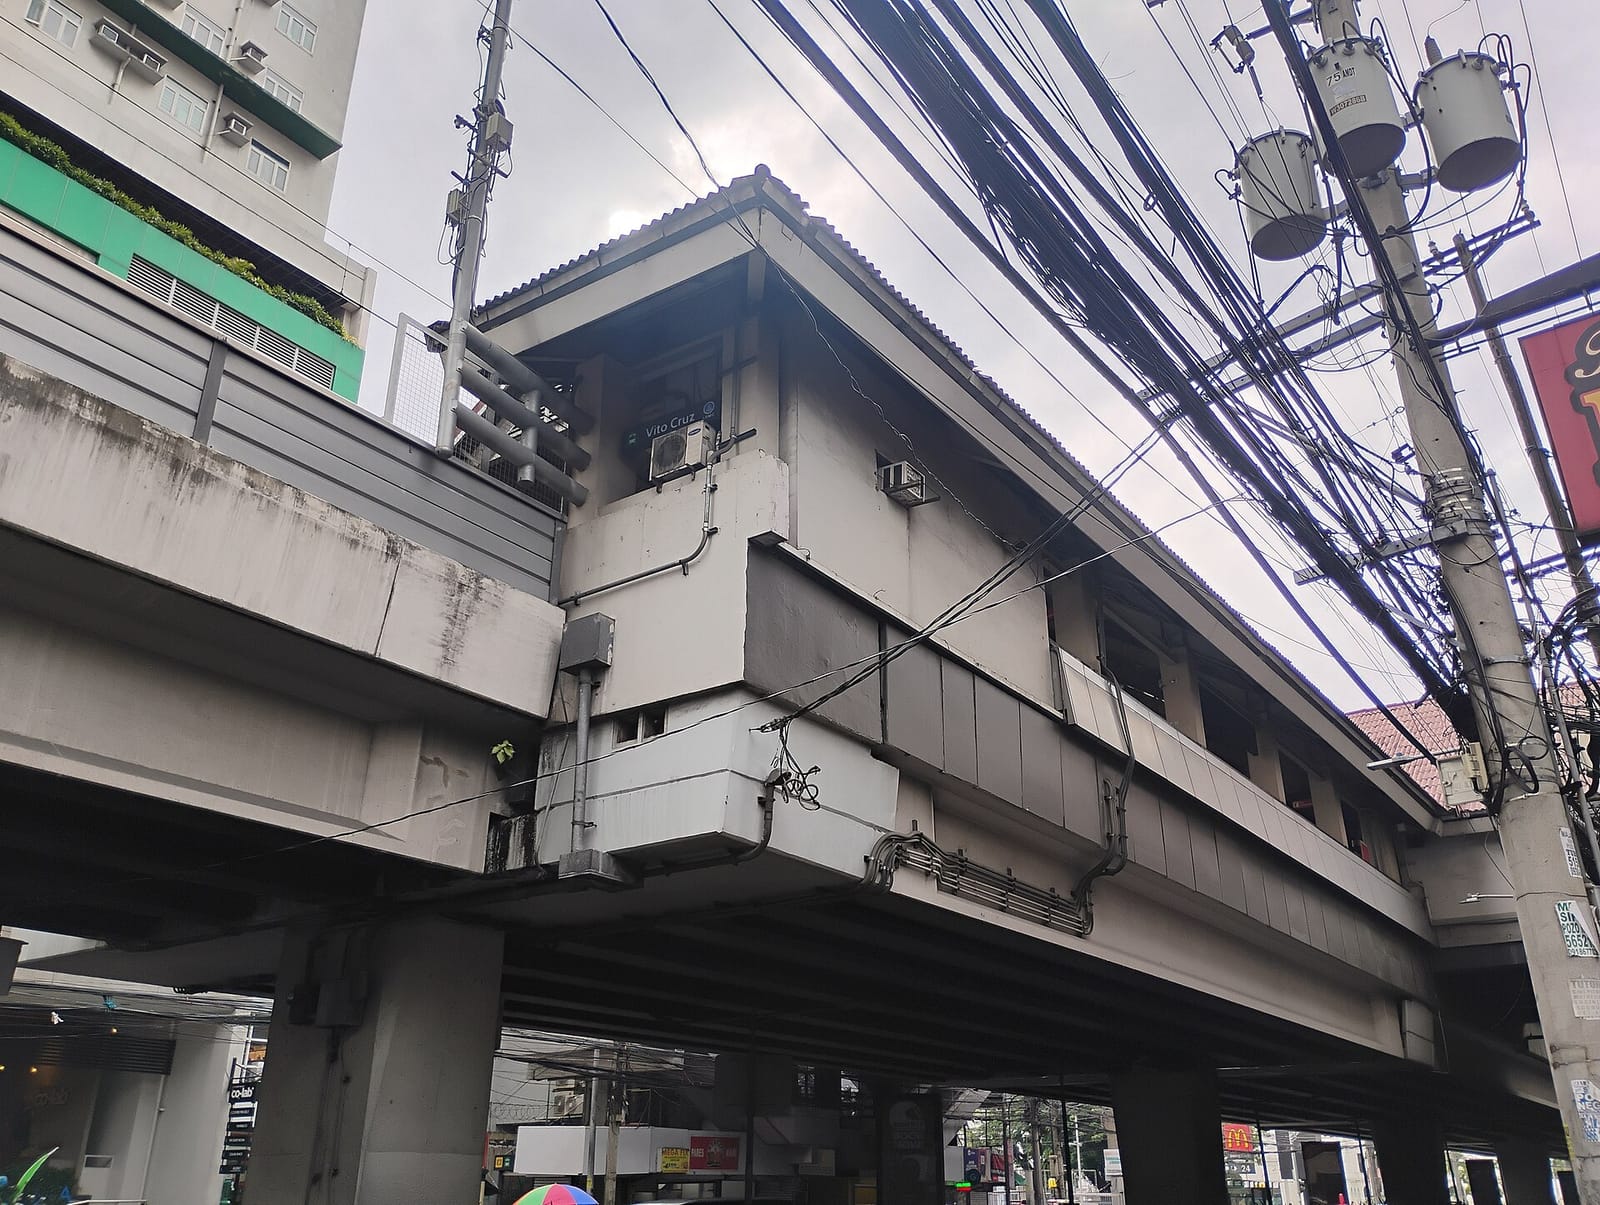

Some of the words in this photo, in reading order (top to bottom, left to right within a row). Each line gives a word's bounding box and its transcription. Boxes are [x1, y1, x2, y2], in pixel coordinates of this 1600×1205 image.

[1326, 72, 1341, 87] 75
[646, 424, 668, 437] Vito
[670, 413, 696, 428] Cruz
